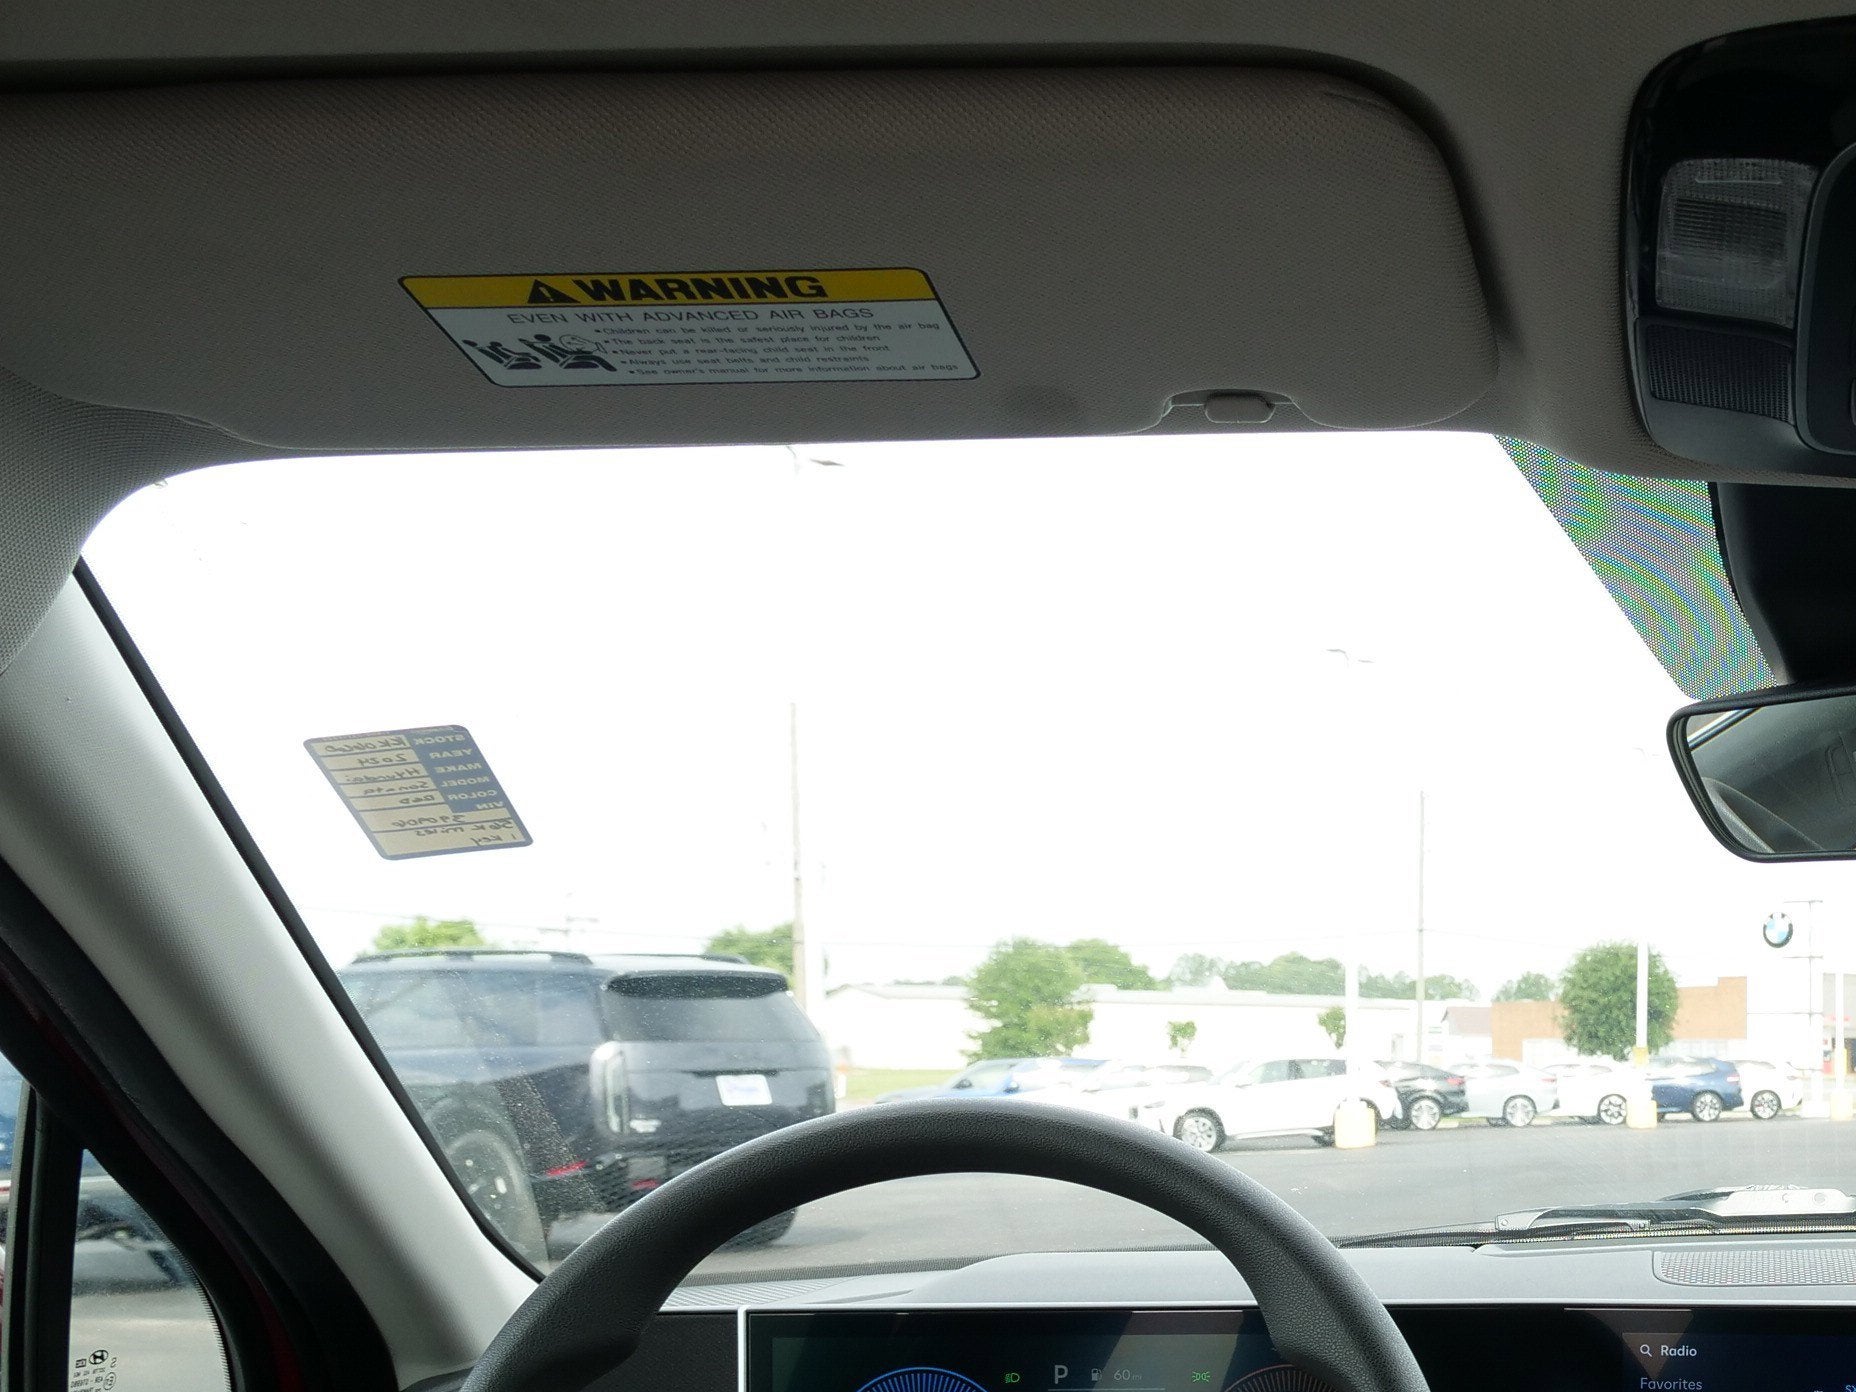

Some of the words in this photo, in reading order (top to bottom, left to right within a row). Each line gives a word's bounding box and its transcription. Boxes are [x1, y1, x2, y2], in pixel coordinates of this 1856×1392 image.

[572, 276, 828, 301] WARNING
[507, 313, 568, 324] EVEN
[576, 312, 634, 323] WITH
[643, 310, 759, 322] ADVANCED
[770, 309, 805, 320] AIR
[814, 308, 875, 319] BAGS
[1660, 1345, 1697, 1356] Radio
[1054, 1364, 1069, 1384] P
[1113, 1369, 1131, 1381] 60
[1640, 1377, 1703, 1390] Favorites
